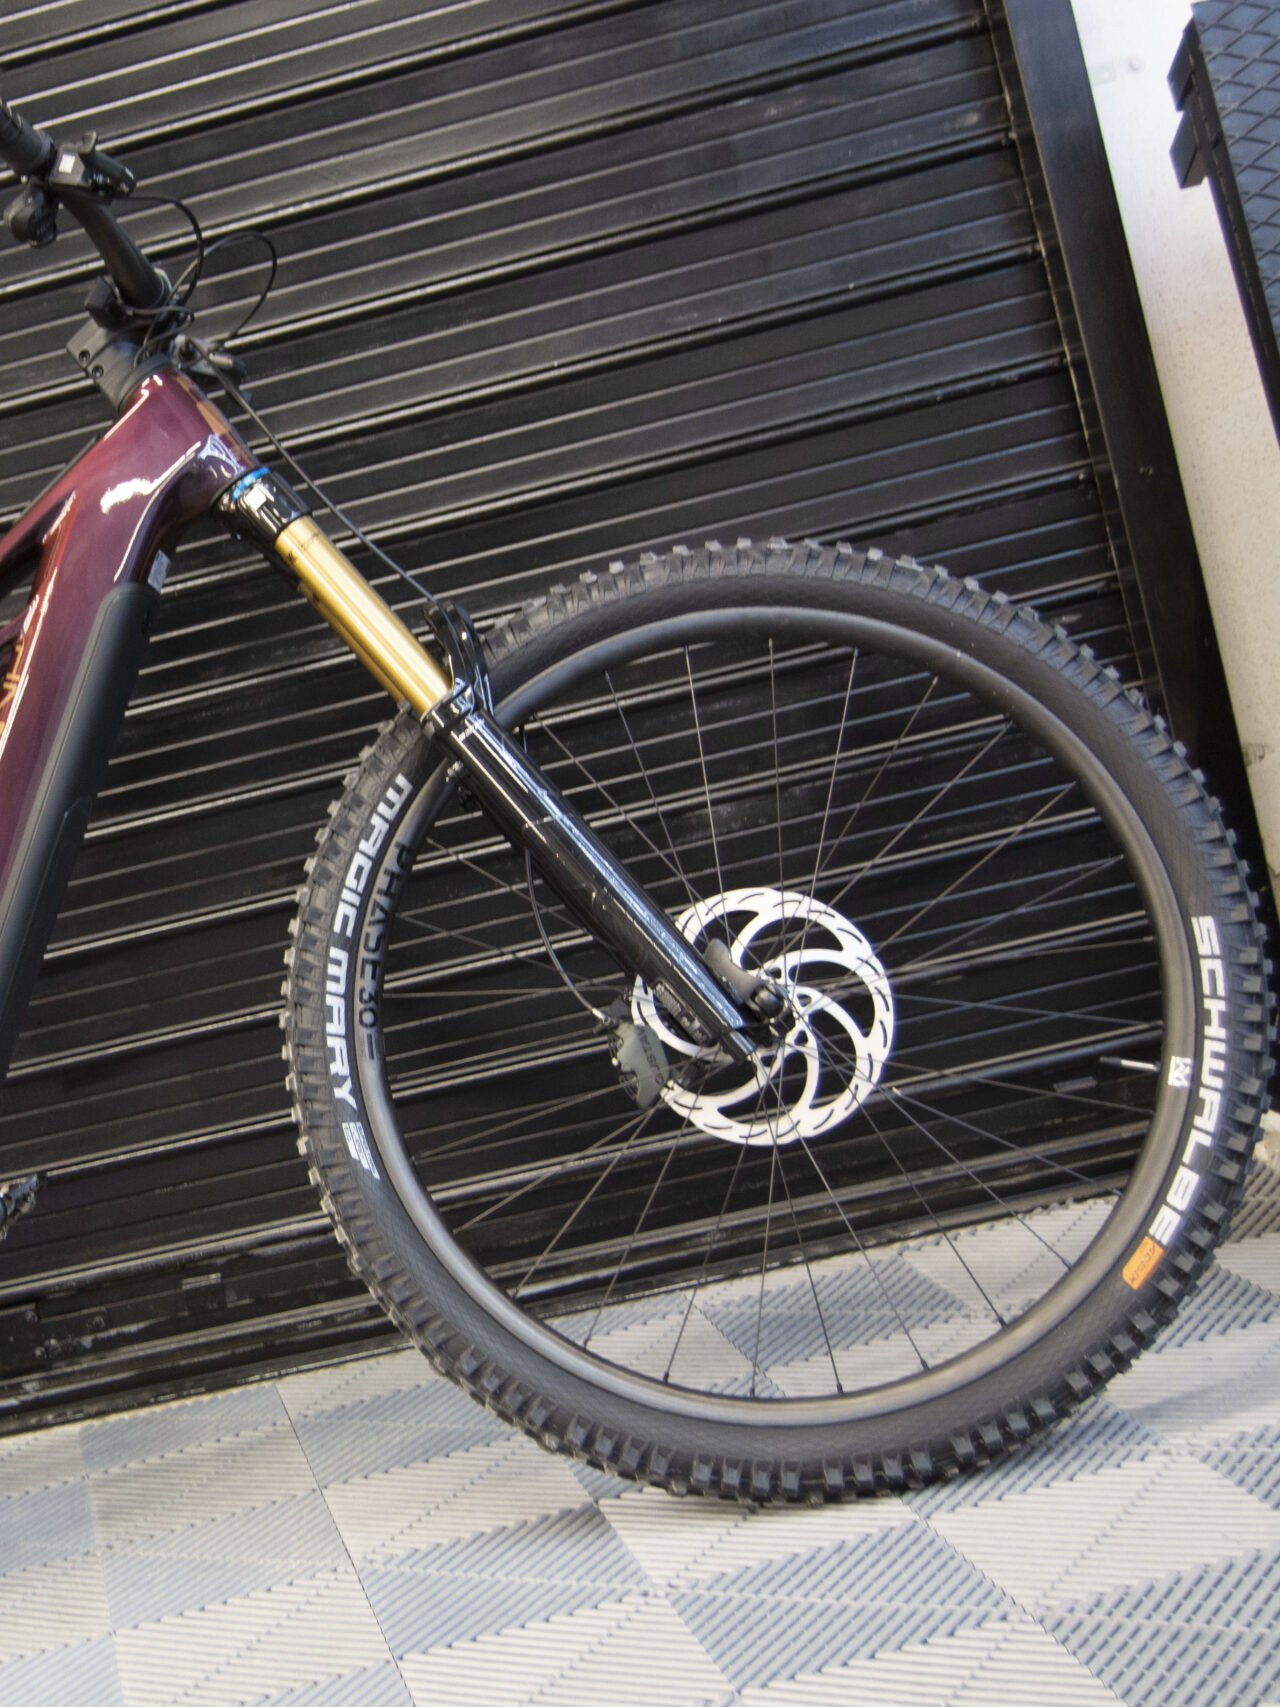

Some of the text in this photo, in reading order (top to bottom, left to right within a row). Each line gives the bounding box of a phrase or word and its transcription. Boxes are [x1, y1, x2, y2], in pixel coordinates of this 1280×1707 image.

[326, 773, 413, 1111] MAGIC MARY
[1150, 914, 1228, 1246] SCHWALBE
